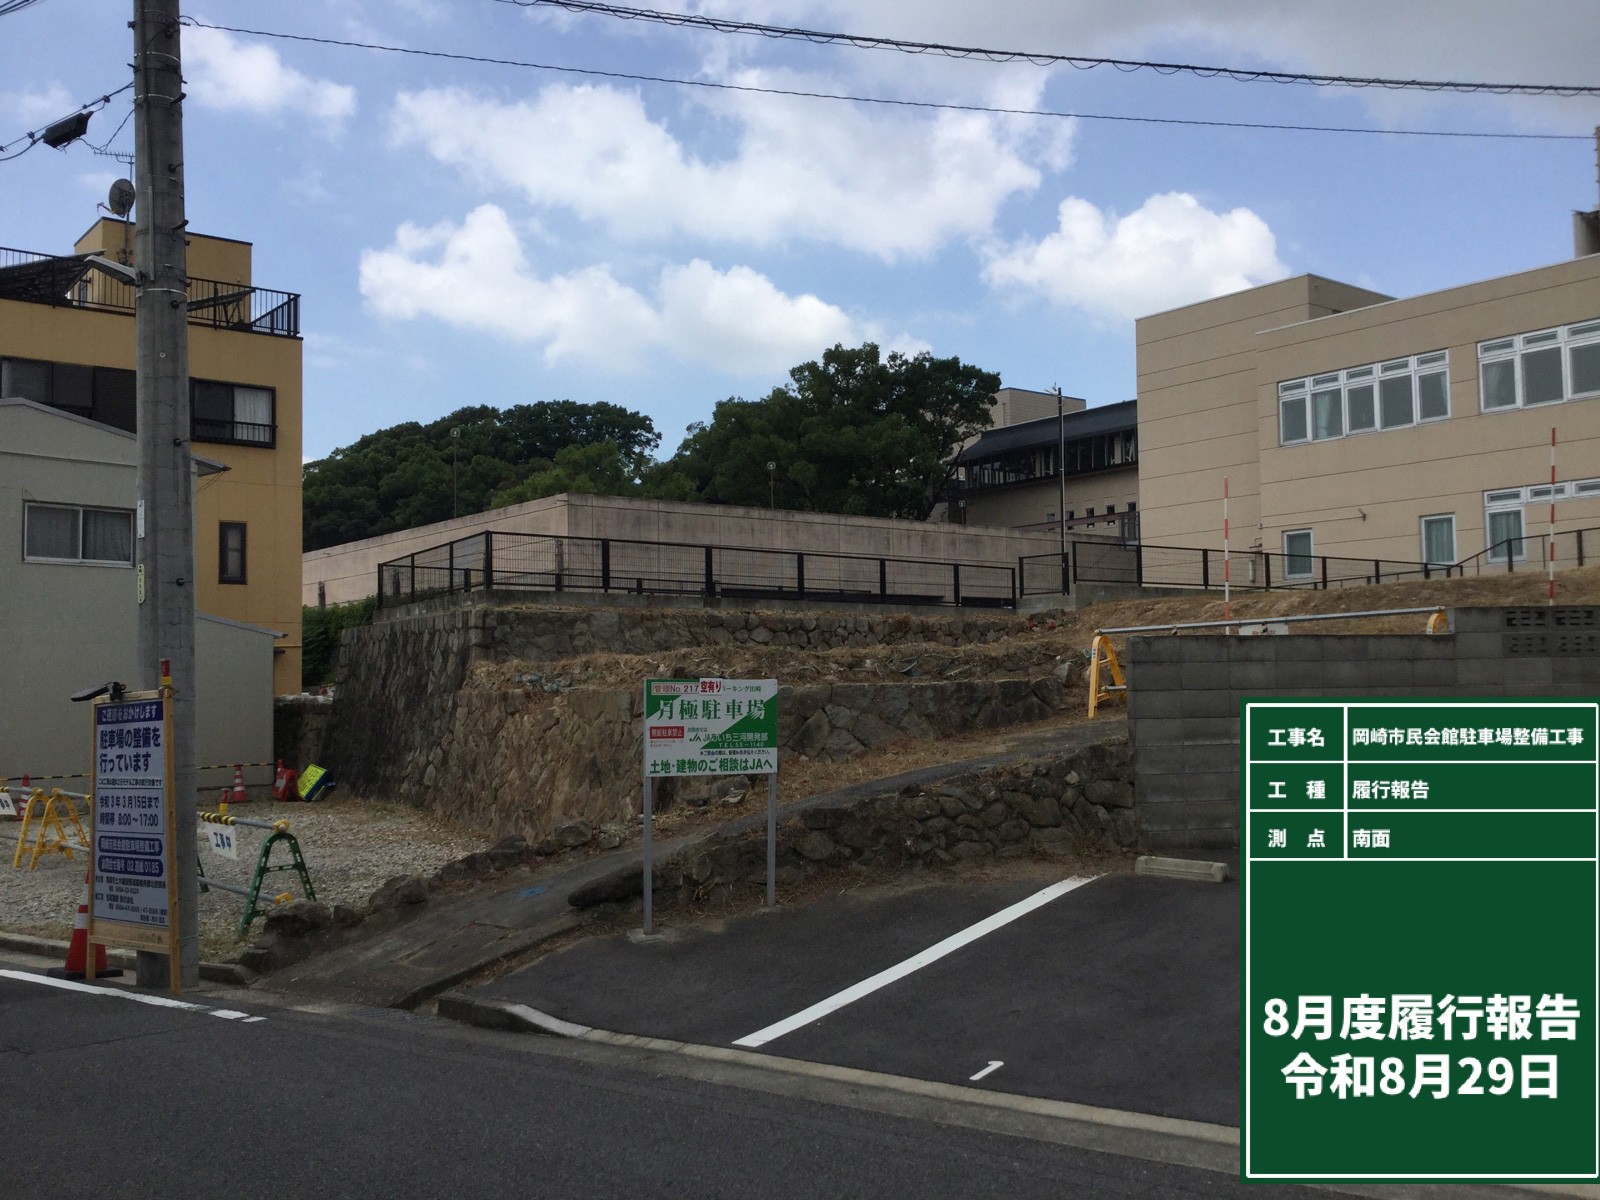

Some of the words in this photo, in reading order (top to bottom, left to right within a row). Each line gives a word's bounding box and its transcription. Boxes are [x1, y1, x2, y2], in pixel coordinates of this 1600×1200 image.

[683, 684, 699, 693] 217
[700, 680, 722, 693] 空有り
[657, 698, 766, 720] 月極駐車場
[100, 726, 161, 749] 駐車場の整備を
[99, 751, 151, 773] 行っています
[650, 758, 773, 774] 土地・建物のご相談はJAへ
[968, 1060, 1005, 1081] 1
